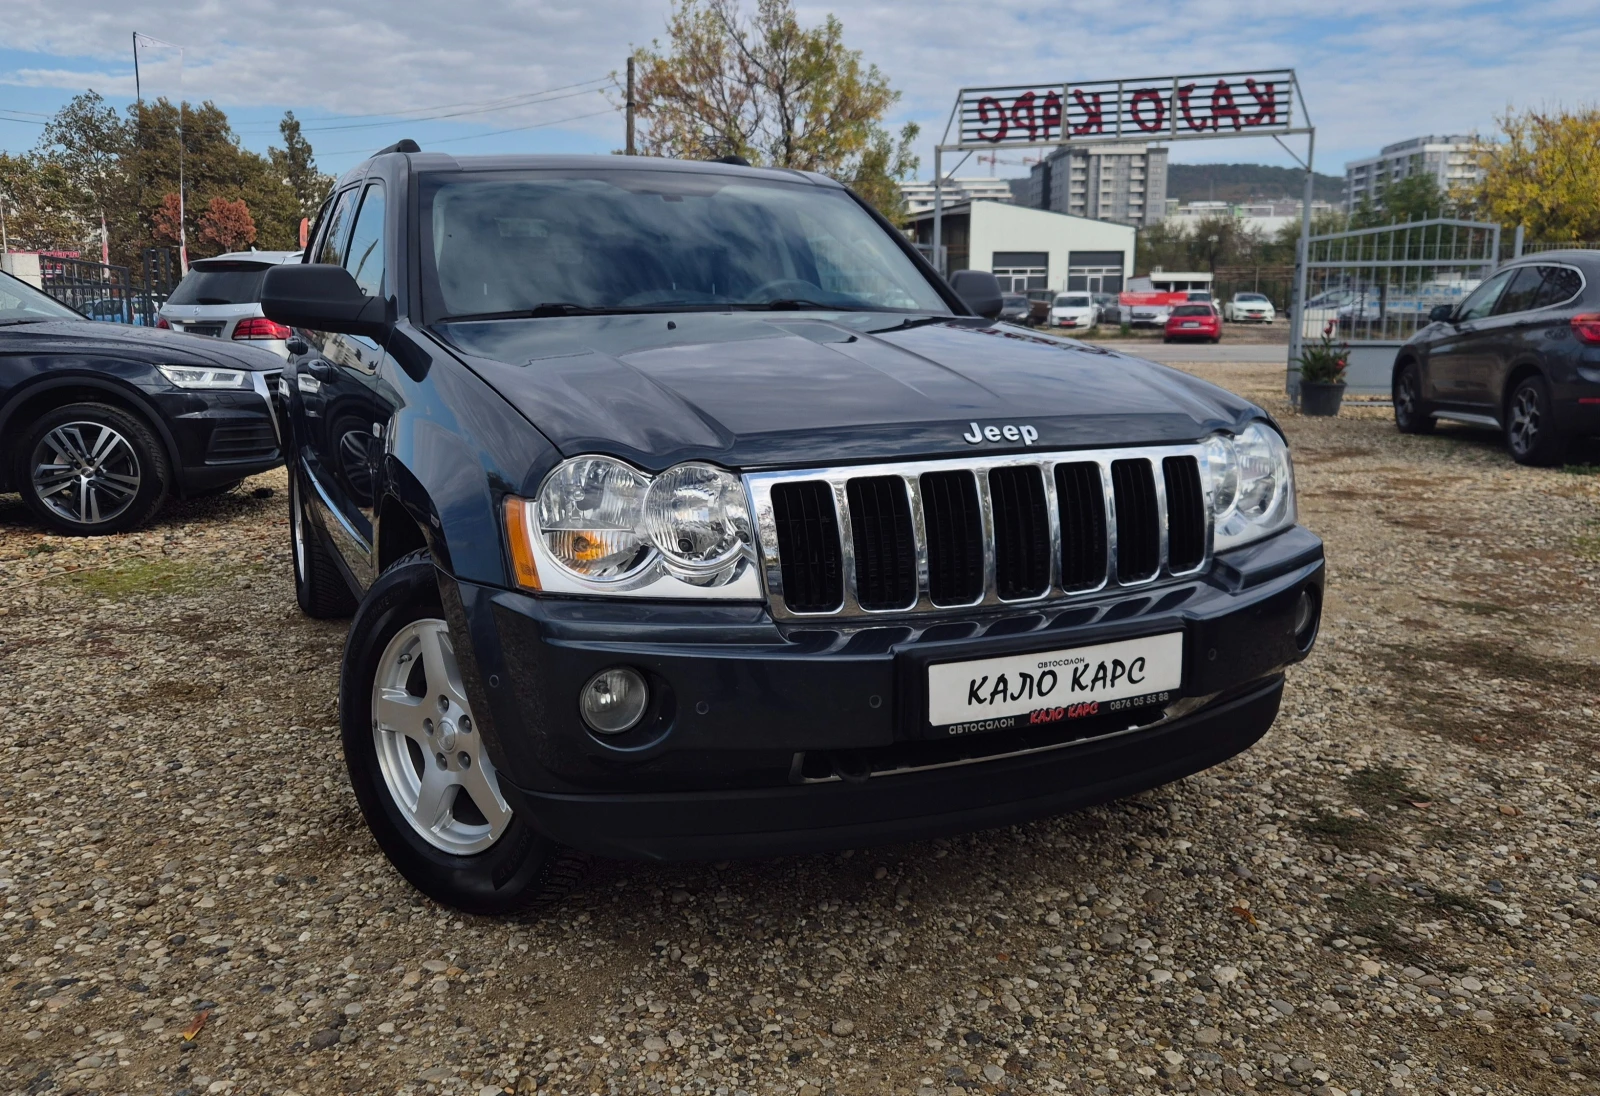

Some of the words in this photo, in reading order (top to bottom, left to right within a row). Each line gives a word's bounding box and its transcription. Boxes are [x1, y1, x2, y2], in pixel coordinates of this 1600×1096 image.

[963, 422, 1039, 446] Jeep
[1037, 657, 1085, 669] автосалон
[968, 669, 1058, 705] КАЛО
[1071, 656, 1146, 692] КАРС
[948, 717, 1015, 735] автосалон
[1029, 707, 1065, 724] КАЛО
[1067, 701, 1099, 718] КАРС
[1110, 699, 1131, 710] 0876
[1133, 697, 1144, 706] 05
[1146, 694, 1157, 704] 55
[1158, 692, 1169, 702] 88
